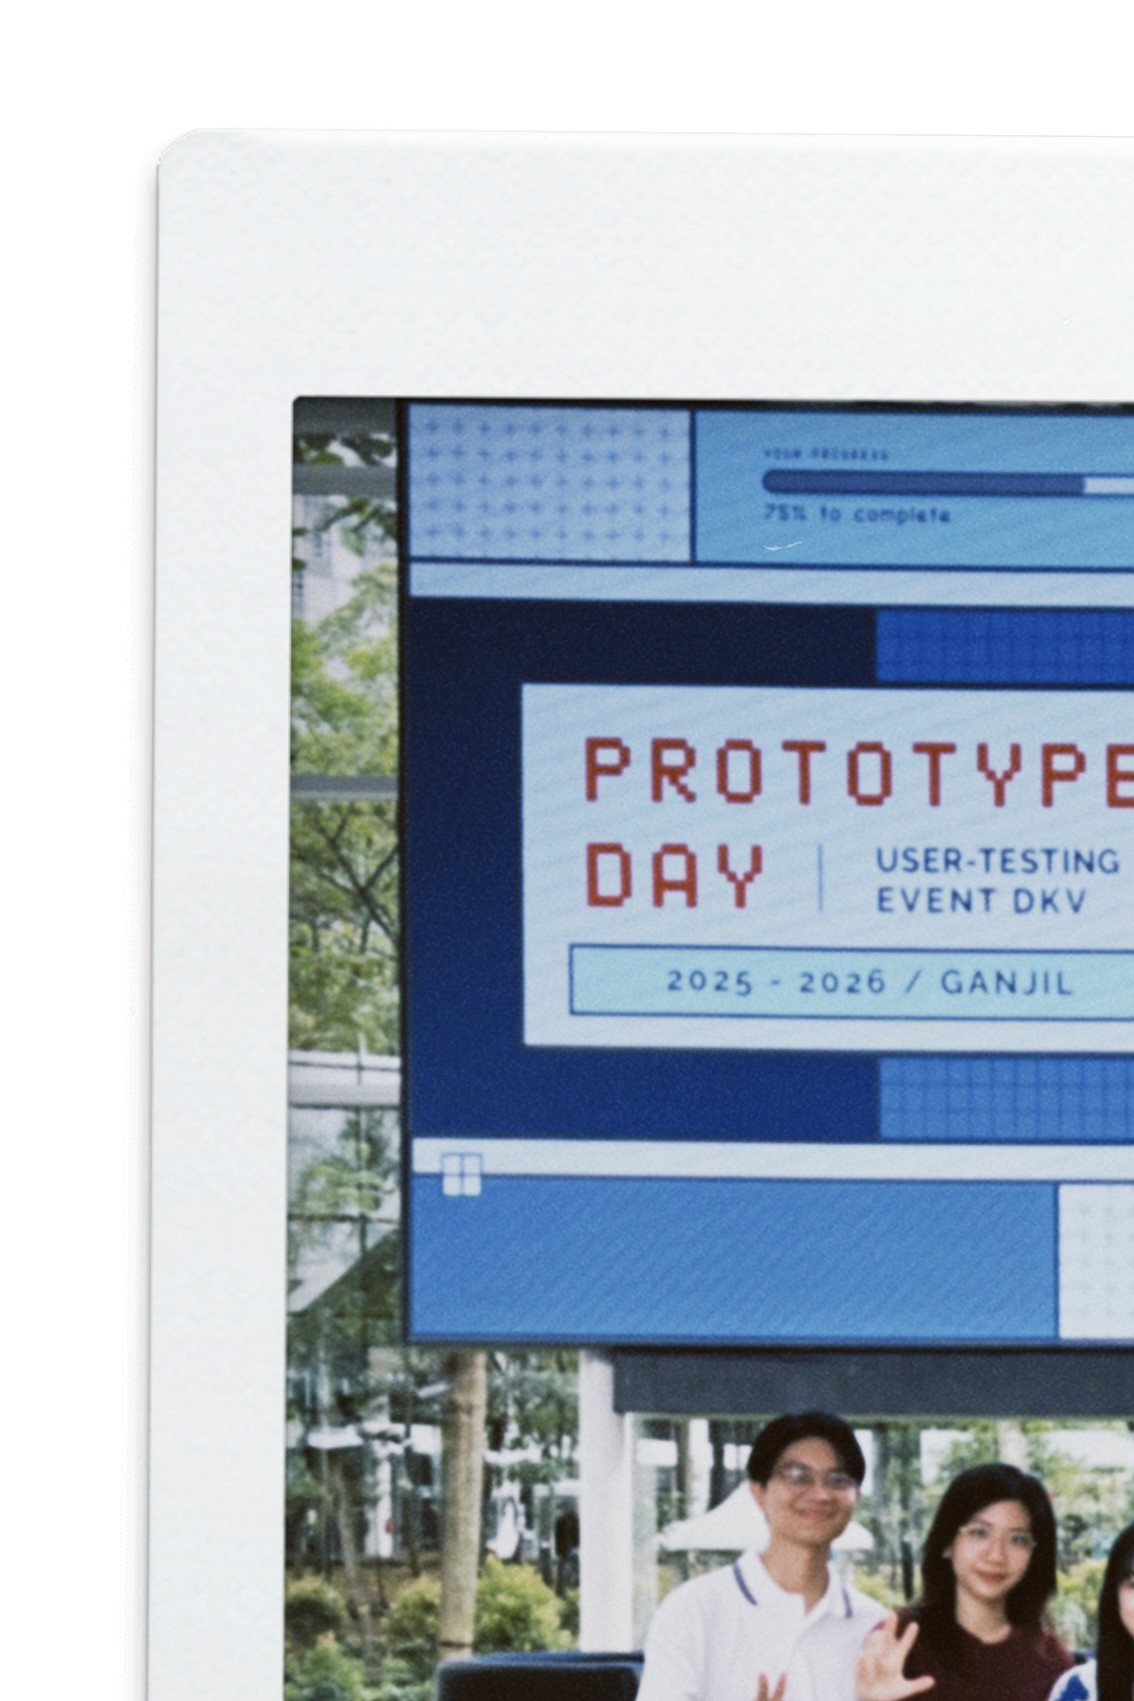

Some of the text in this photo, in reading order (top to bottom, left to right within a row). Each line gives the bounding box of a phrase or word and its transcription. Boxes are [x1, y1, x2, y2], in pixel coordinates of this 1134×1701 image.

[765, 504, 950, 525] 75% to complete
[877, 847, 1119, 874] USER-TESTING
[587, 843, 762, 908] DAY
[878, 887, 1085, 914] EVENT DKV
[667, 970, 752, 996] 2025
[800, 969, 885, 994] 2026
[905, 969, 922, 994] /
[941, 969, 1071, 995] GANJIL
